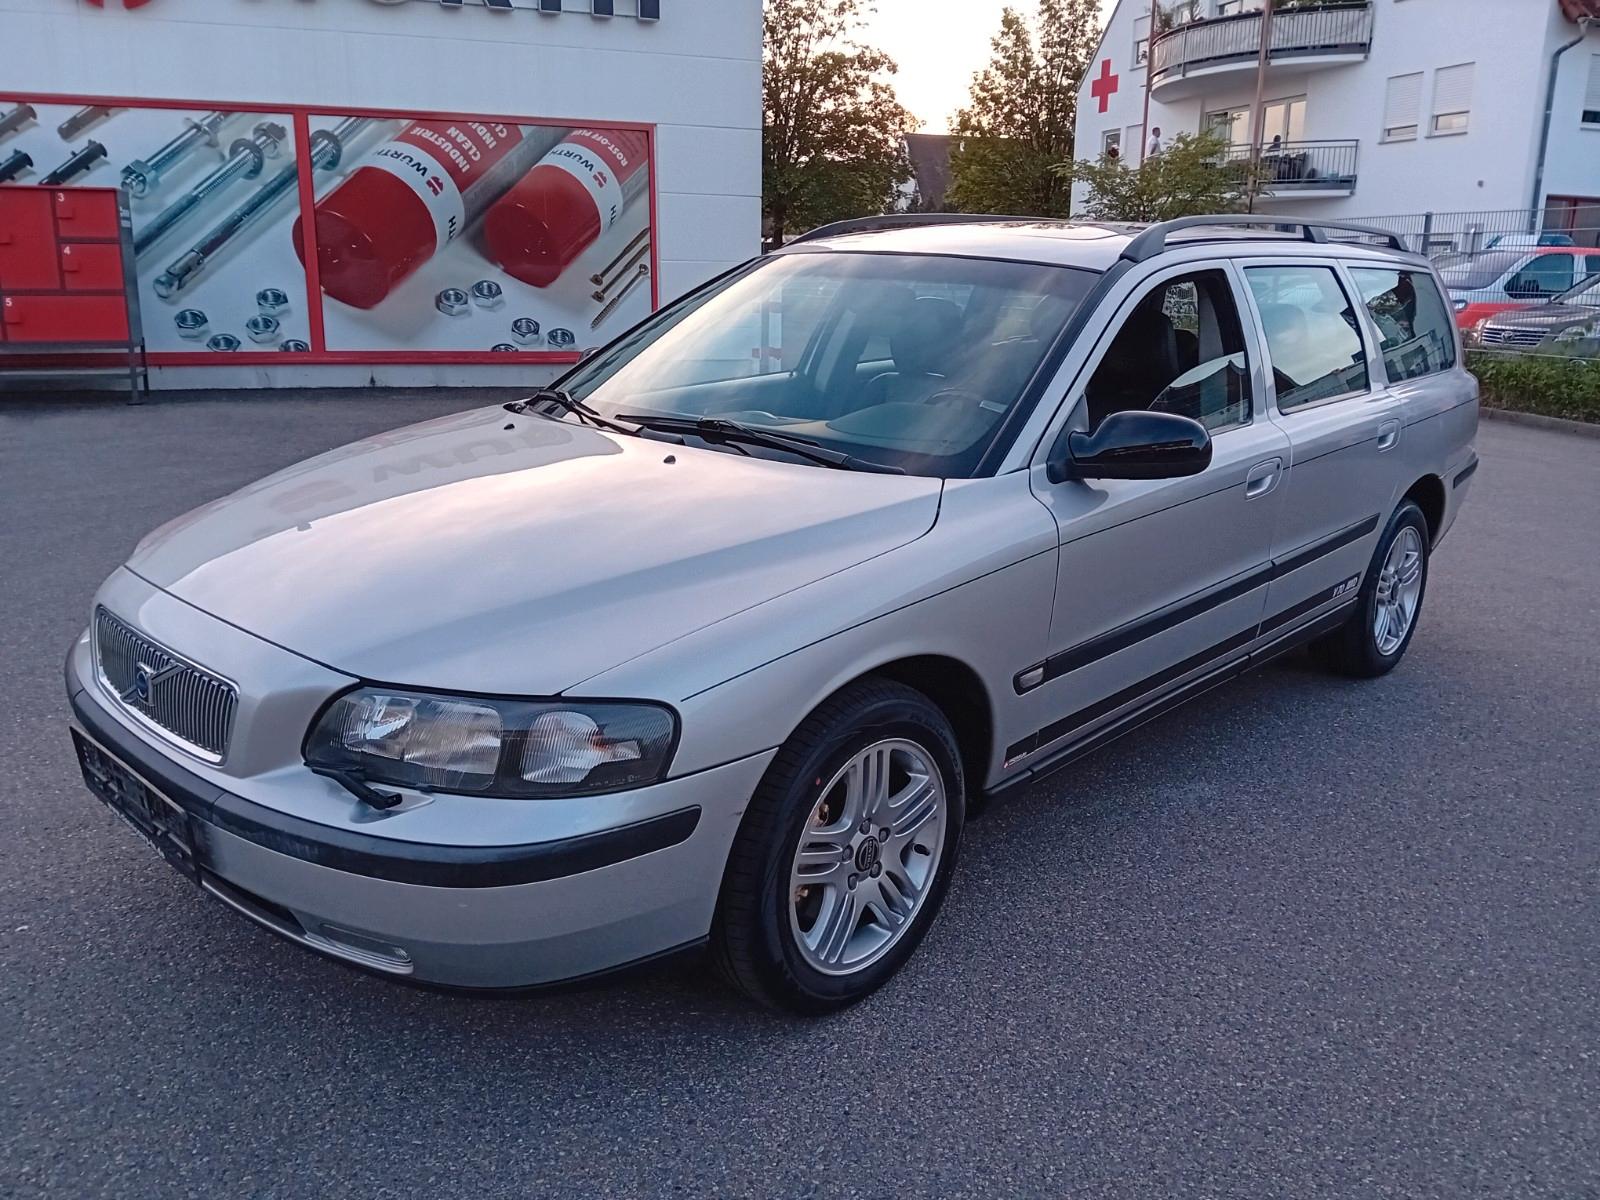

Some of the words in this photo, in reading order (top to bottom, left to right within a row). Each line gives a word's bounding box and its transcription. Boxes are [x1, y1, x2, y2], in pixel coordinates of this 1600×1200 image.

[446, 126, 481, 161] CLEAN
[409, 126, 471, 173] INDUSTRIE
[57, 192, 65, 202] 3
[63, 246, 71, 255] 4
[5, 297, 13, 307] 5
